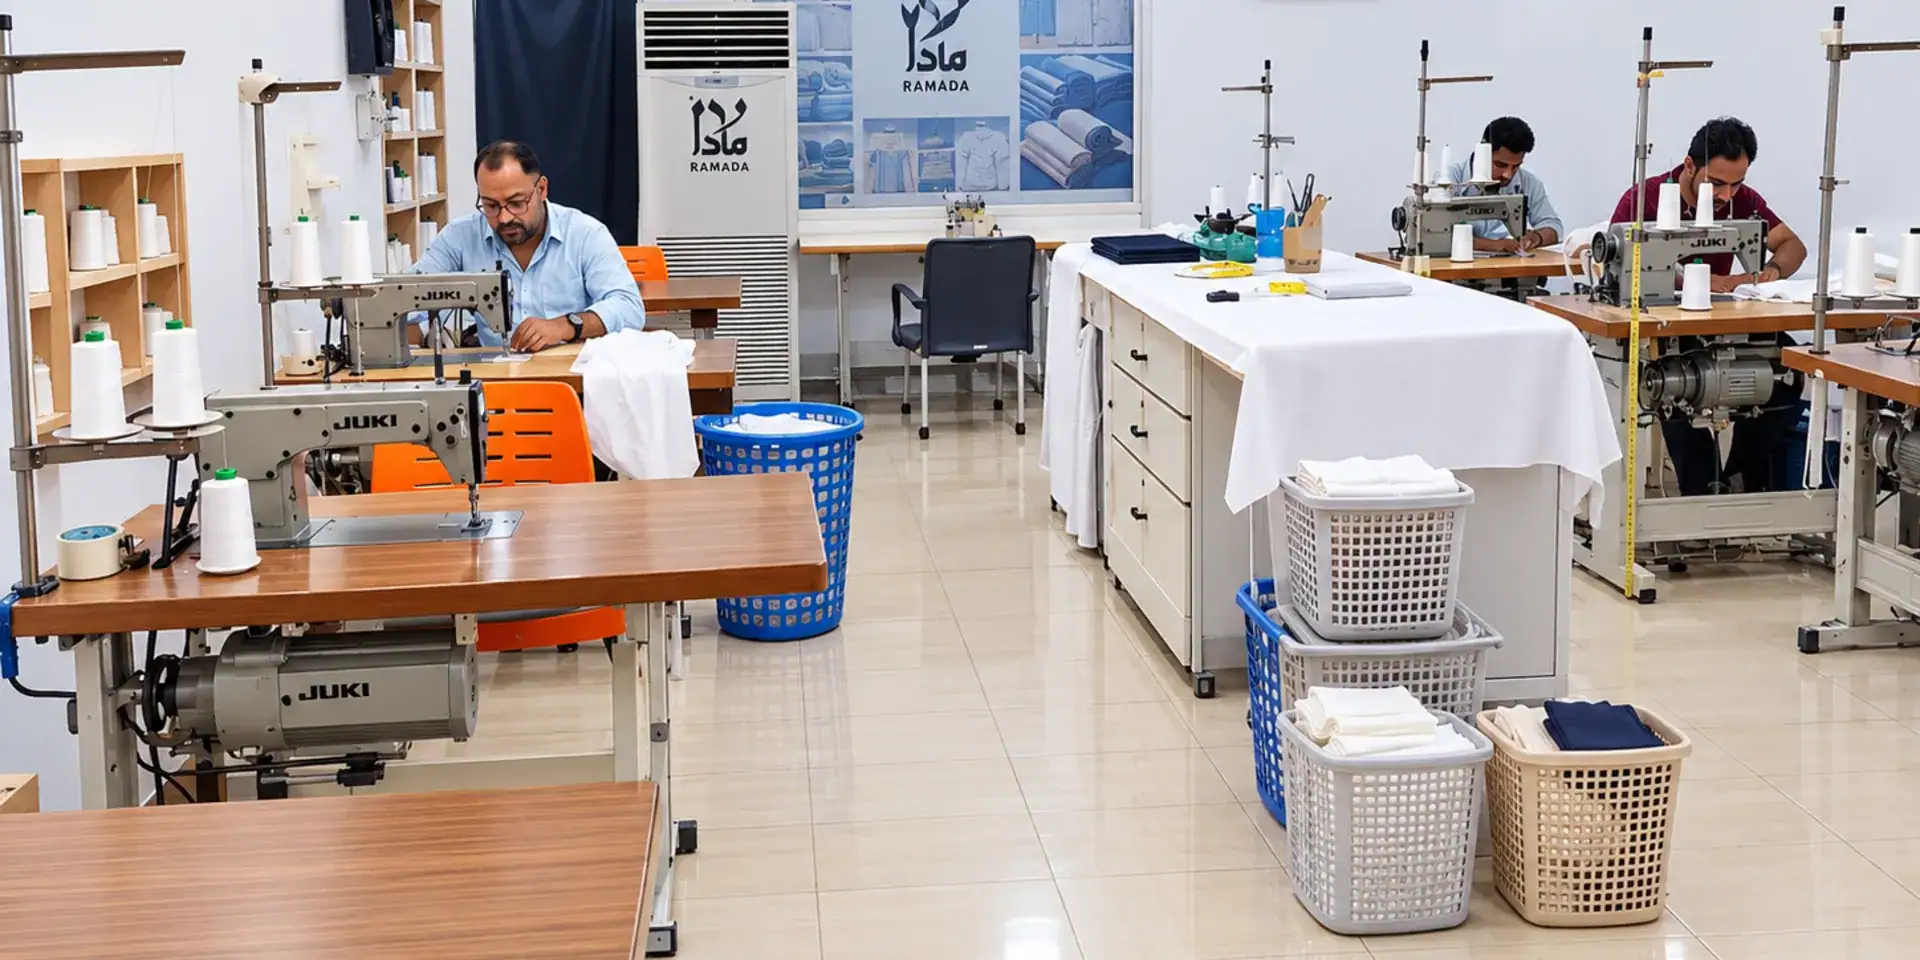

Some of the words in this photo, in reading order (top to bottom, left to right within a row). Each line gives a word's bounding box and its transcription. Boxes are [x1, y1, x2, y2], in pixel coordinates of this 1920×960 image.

[903, 80, 969, 92] RAMADA
[690, 162, 749, 172] RAMADA
[1690, 238, 1726, 248] JUKI
[421, 291, 461, 301] JUKI
[333, 414, 397, 430] JUKI
[298, 682, 369, 701] JUKI
